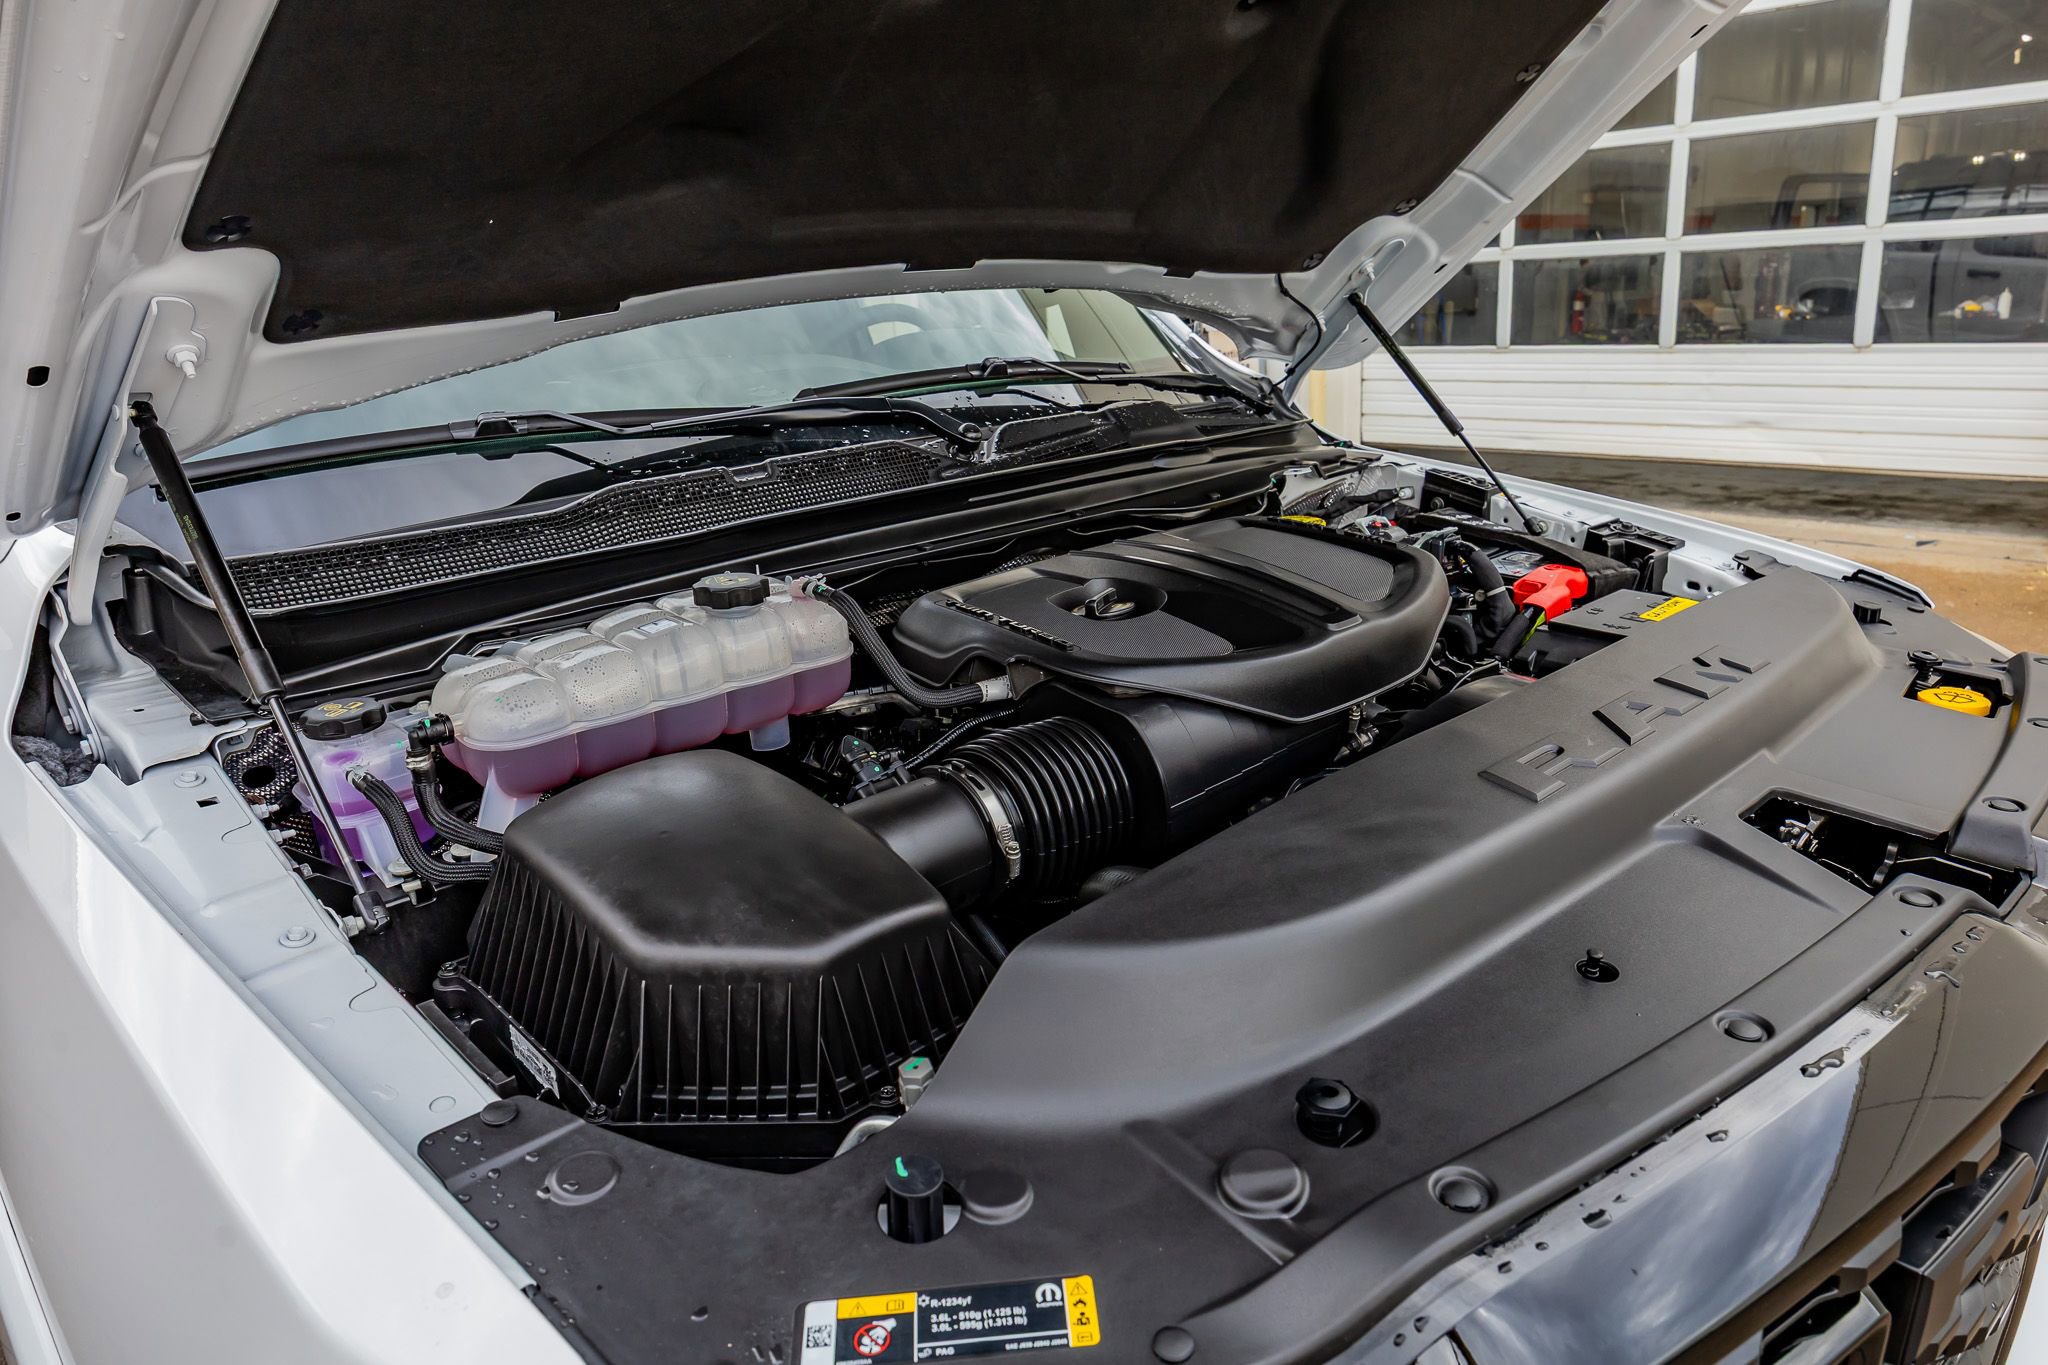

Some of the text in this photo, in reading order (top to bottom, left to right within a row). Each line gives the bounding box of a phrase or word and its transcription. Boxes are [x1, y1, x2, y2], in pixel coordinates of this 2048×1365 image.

[1477, 644, 1772, 804] RAM
[930, 1295, 972, 1308] R-1234yf
[1012, 1305, 1027, 1316] lb)
[1014, 1315, 1028, 1326] lb)
[935, 1346, 955, 1357] PAG
